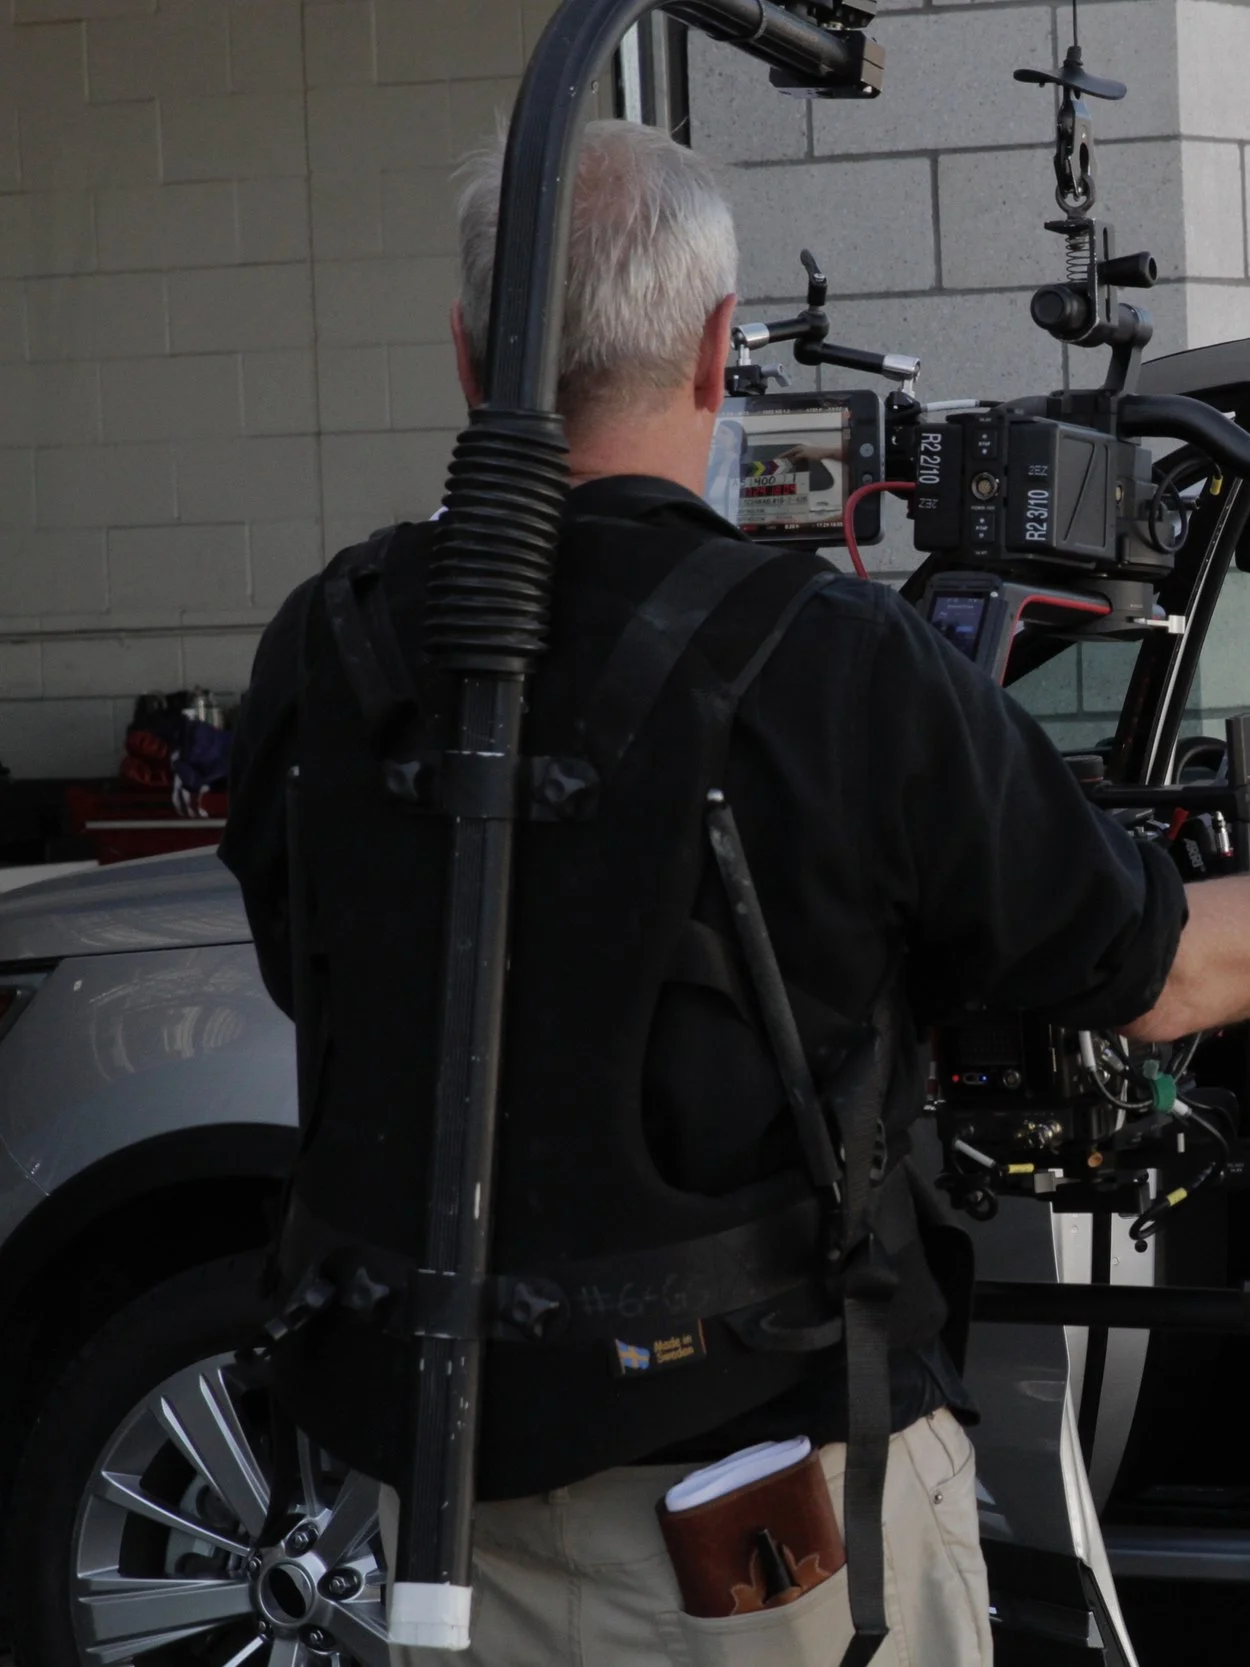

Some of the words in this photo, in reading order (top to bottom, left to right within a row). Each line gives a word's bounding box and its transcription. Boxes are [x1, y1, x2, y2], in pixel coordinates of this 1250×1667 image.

[921, 432, 942, 452] R2
[918, 455, 941, 485] 2/10
[1025, 489, 1049, 519] 3/10
[1025, 522, 1047, 541] R2
[1183, 837, 1204, 868] ARRI
